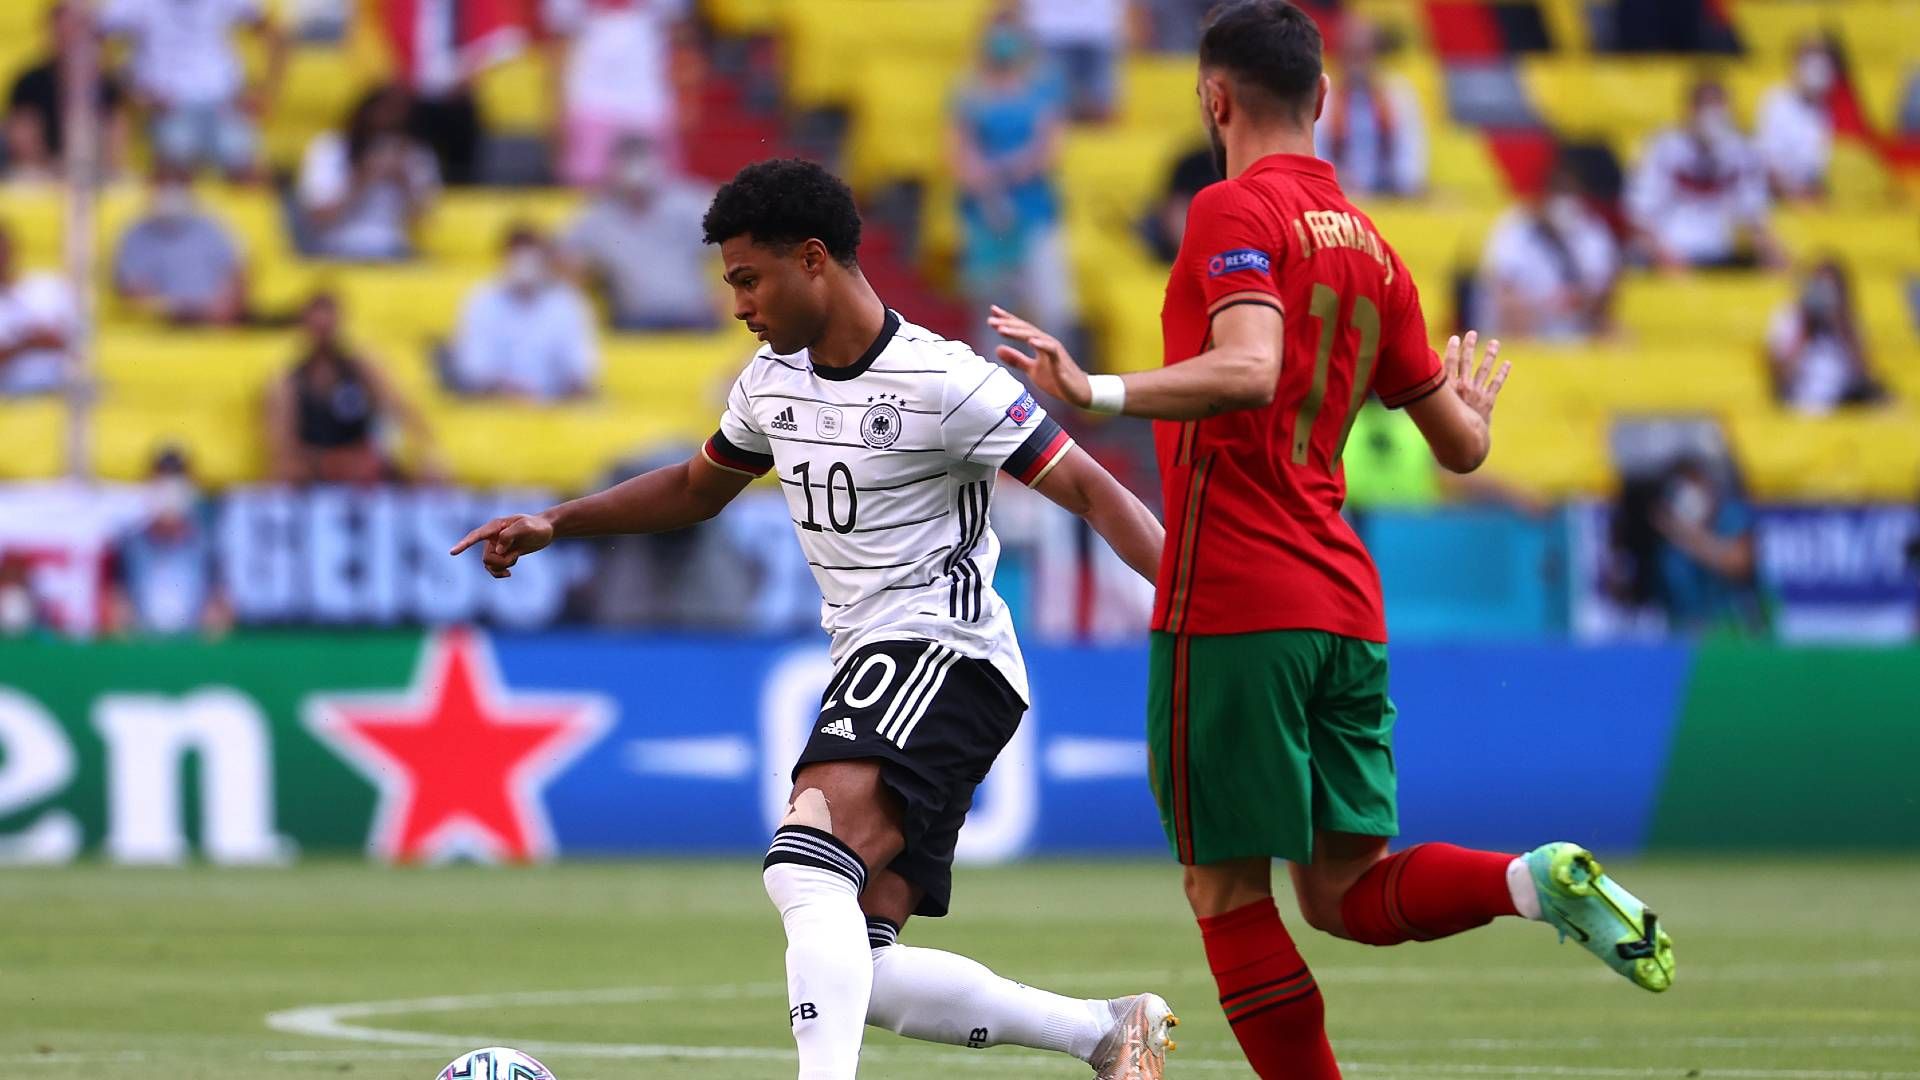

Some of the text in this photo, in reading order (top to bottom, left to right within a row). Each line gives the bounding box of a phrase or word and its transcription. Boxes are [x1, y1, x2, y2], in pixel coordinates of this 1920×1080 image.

[1225, 253, 1270, 269] RESPECT
[1291, 282, 1381, 475] 11
[771, 420, 798, 432] adidas
[792, 461, 858, 535] 10
[821, 653, 897, 712] 10
[821, 726, 857, 741] adidas
[0, 682, 298, 868] en
[790, 1002, 818, 1027] FB
